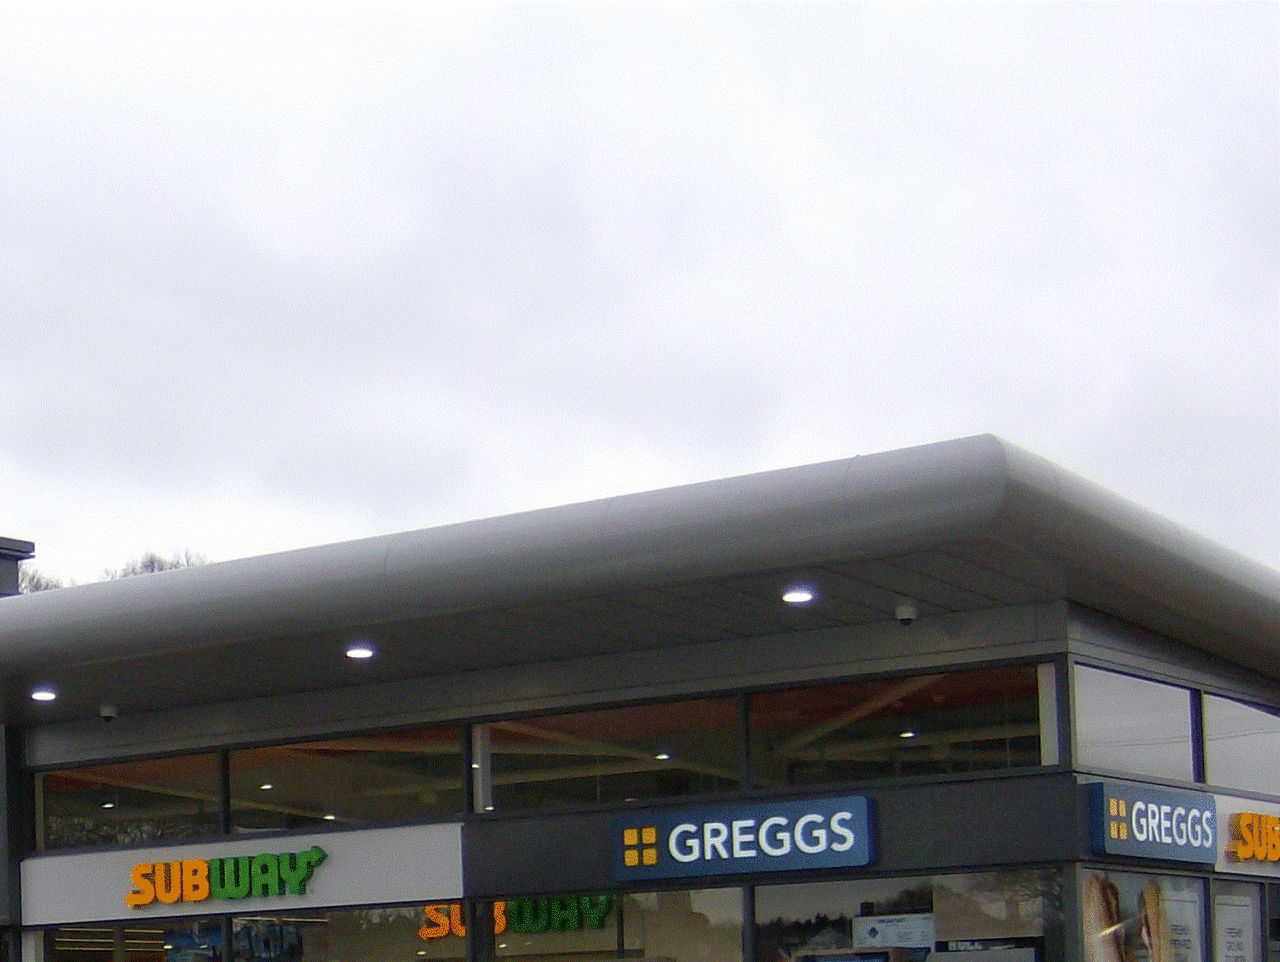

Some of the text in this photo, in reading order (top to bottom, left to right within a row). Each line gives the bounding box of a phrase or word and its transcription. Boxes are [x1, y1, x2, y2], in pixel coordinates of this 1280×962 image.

[668, 811, 855, 863] GREGGS
[1131, 801, 1213, 848] GREGGS
[126, 847, 328, 907] SUBWAY
